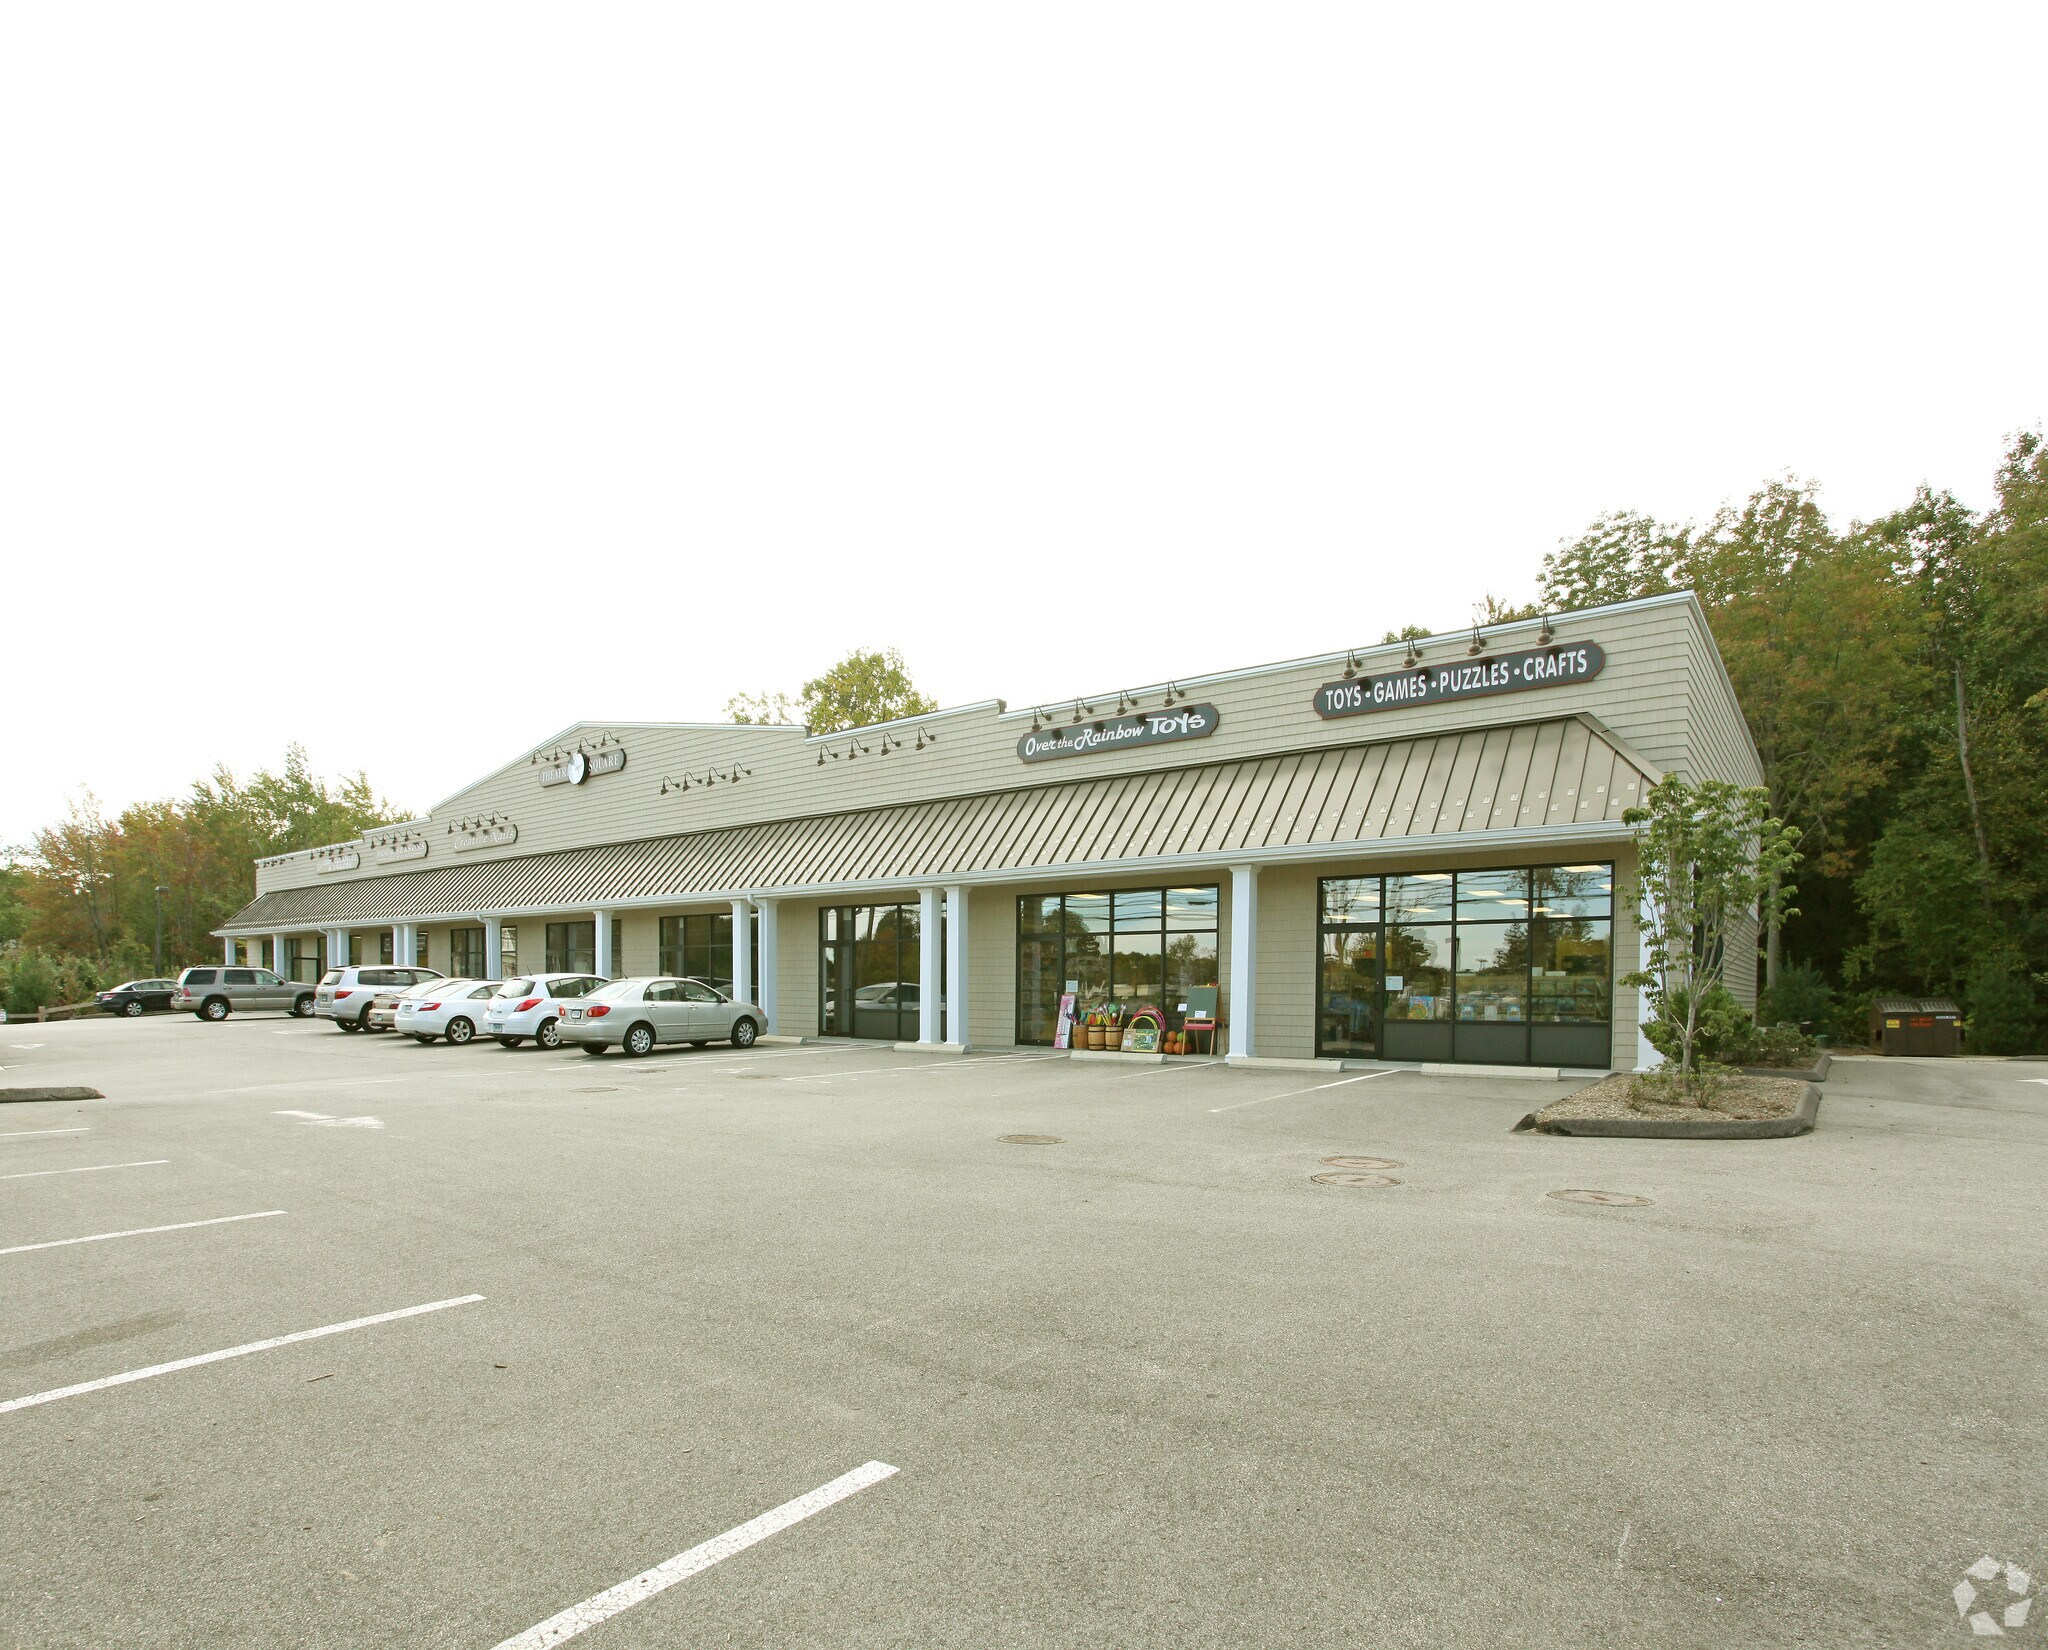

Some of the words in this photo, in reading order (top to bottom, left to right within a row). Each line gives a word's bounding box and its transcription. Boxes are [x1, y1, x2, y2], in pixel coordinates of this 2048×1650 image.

[1326, 685, 1362, 711] TOYS
[1374, 675, 1427, 703] GAMES
[1440, 661, 1509, 693] PUZZLES
[1523, 649, 1587, 681] CRAFTS
[1025, 737, 1057, 756] Over
[1057, 736, 1073, 748] the
[1074, 724, 1145, 751] Rainbow
[542, 767, 569, 782] THEATR
[589, 754, 619, 773] SQUARE
[454, 834, 488, 850] Creative
[490, 827, 514, 843] Nails
